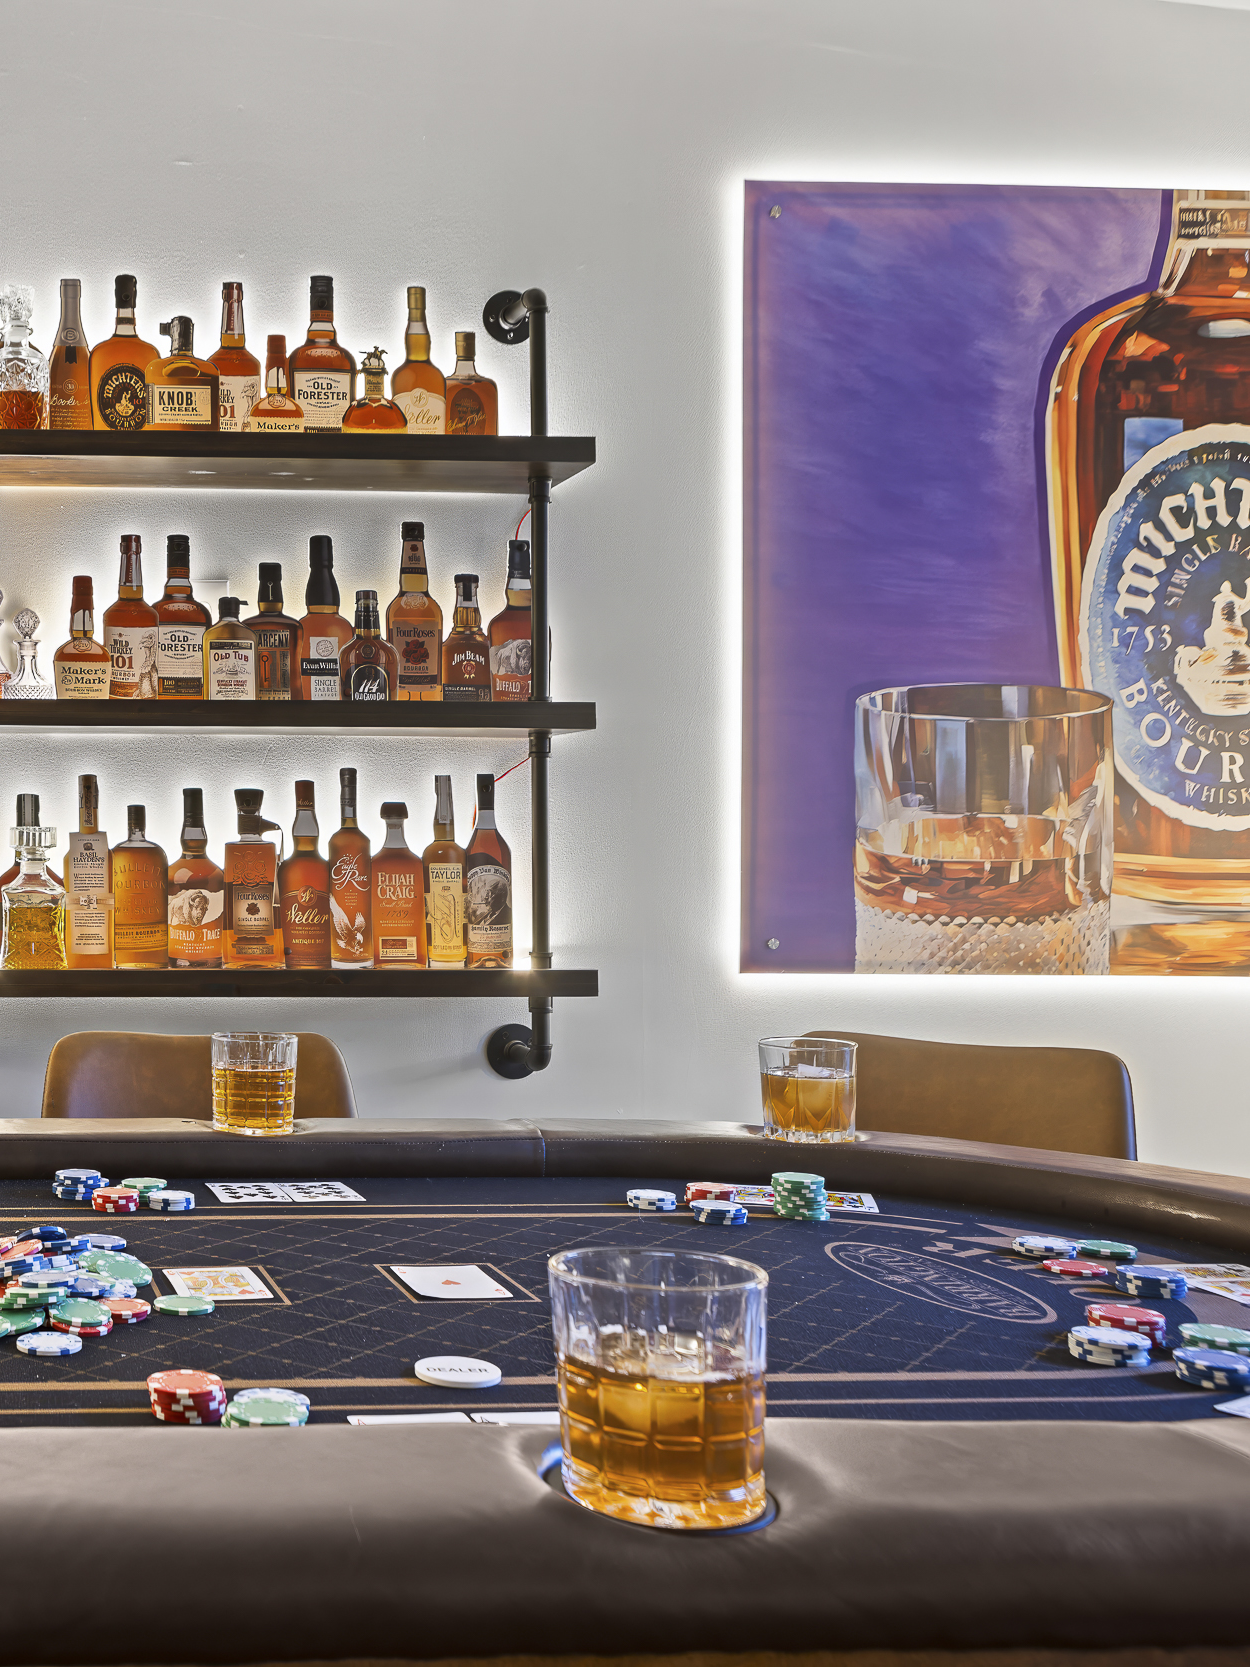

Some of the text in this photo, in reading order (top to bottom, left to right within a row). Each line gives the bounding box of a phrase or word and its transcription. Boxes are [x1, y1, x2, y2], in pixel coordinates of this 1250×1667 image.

[104, 372, 146, 398] MICHTER'S
[313, 382, 333, 390] OLD
[158, 390, 193, 406] KNOB
[220, 388, 232, 396] ILD
[298, 390, 348, 400] FORESTER
[220, 404, 236, 418] 01
[257, 422, 300, 430] Maker's
[170, 634, 188, 642] OLD
[396, 627, 436, 638] Four Roses
[112, 638, 130, 647] WILD
[258, 634, 289, 648] ARCENY
[110, 644, 134, 654] TURKEY
[110, 655, 134, 670] 101
[214, 651, 248, 662] OLD TUB
[452, 650, 484, 666] JIM BEAM
[61, 666, 106, 675] Maker's
[74, 676, 106, 685] Mark
[358, 679, 380, 692] 114
[496, 678, 520, 692] BUFFALO
[1119, 676, 1246, 784] BOUR
[332, 853, 362, 884] Eagle
[336, 869, 370, 892] Rare
[377, 872, 414, 886] ELIJAH
[430, 871, 461, 880] TAYLOR
[116, 880, 166, 889] OURBON
[237, 892, 270, 900] Four Roses
[377, 885, 414, 900] CRAIG
[286, 902, 328, 924] Weller
[170, 926, 220, 942] BUFFALO TRACE
[922, 1240, 1142, 1305] OKER
[426, 1366, 490, 1374] DEALER
